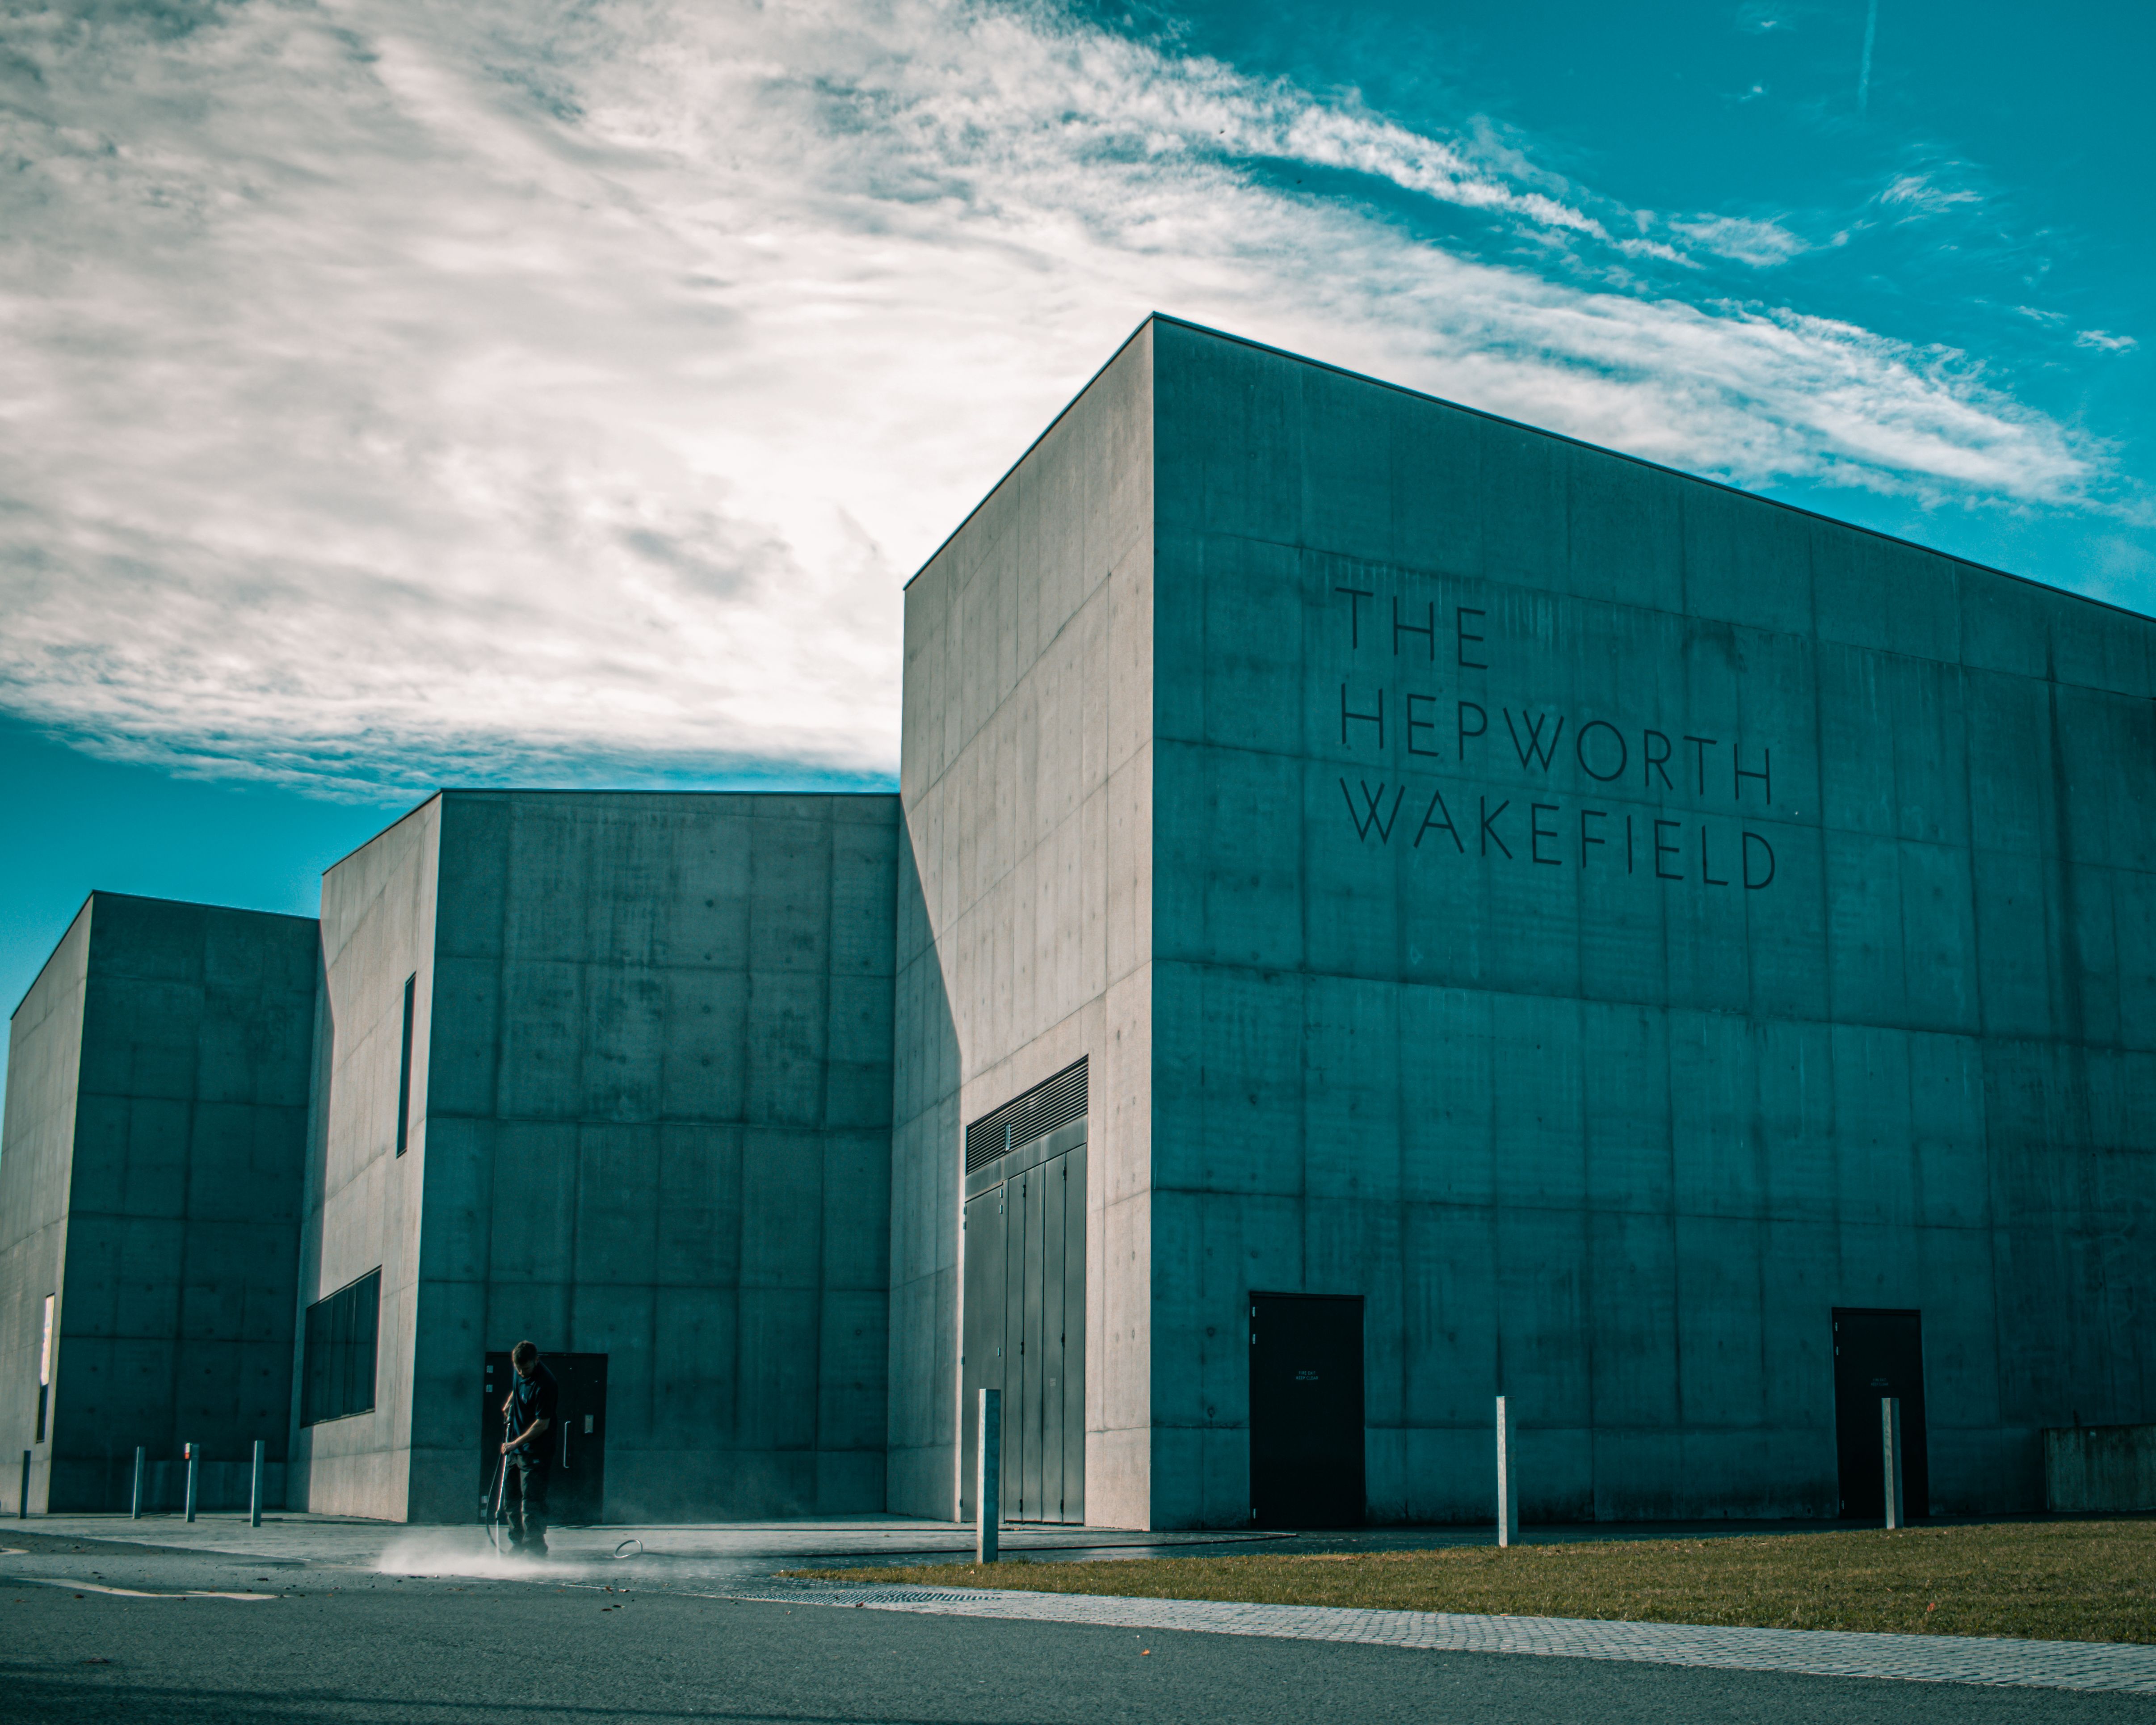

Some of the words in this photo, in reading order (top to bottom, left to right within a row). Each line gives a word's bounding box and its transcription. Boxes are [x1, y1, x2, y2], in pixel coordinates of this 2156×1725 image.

[1335, 587, 1488, 670] THE
[1341, 683, 1771, 805] HEPWORTH
[1340, 777, 1775, 890] WAKEFIELD
